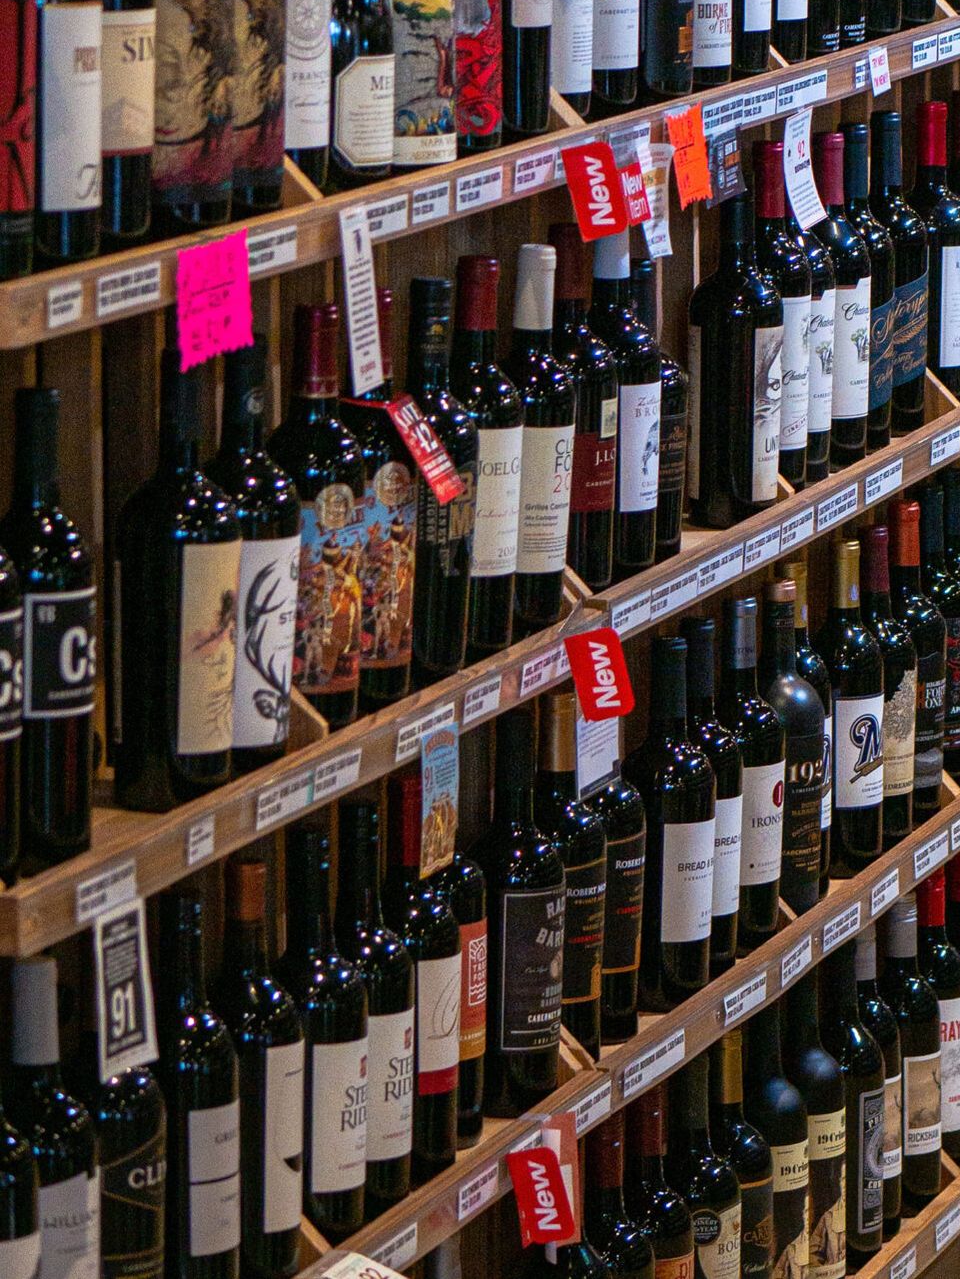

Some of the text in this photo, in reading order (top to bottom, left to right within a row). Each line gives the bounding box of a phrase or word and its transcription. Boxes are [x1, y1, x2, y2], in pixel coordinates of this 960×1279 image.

[584, 154, 616, 226] New
[621, 171, 643, 197] New
[588, 641, 622, 709] New
[615, 857, 641, 870] ROBERT
[567, 886, 597, 898] ROBERT
[908, 1129, 939, 1143] RICKSHAW
[528, 1160, 562, 1231] New
